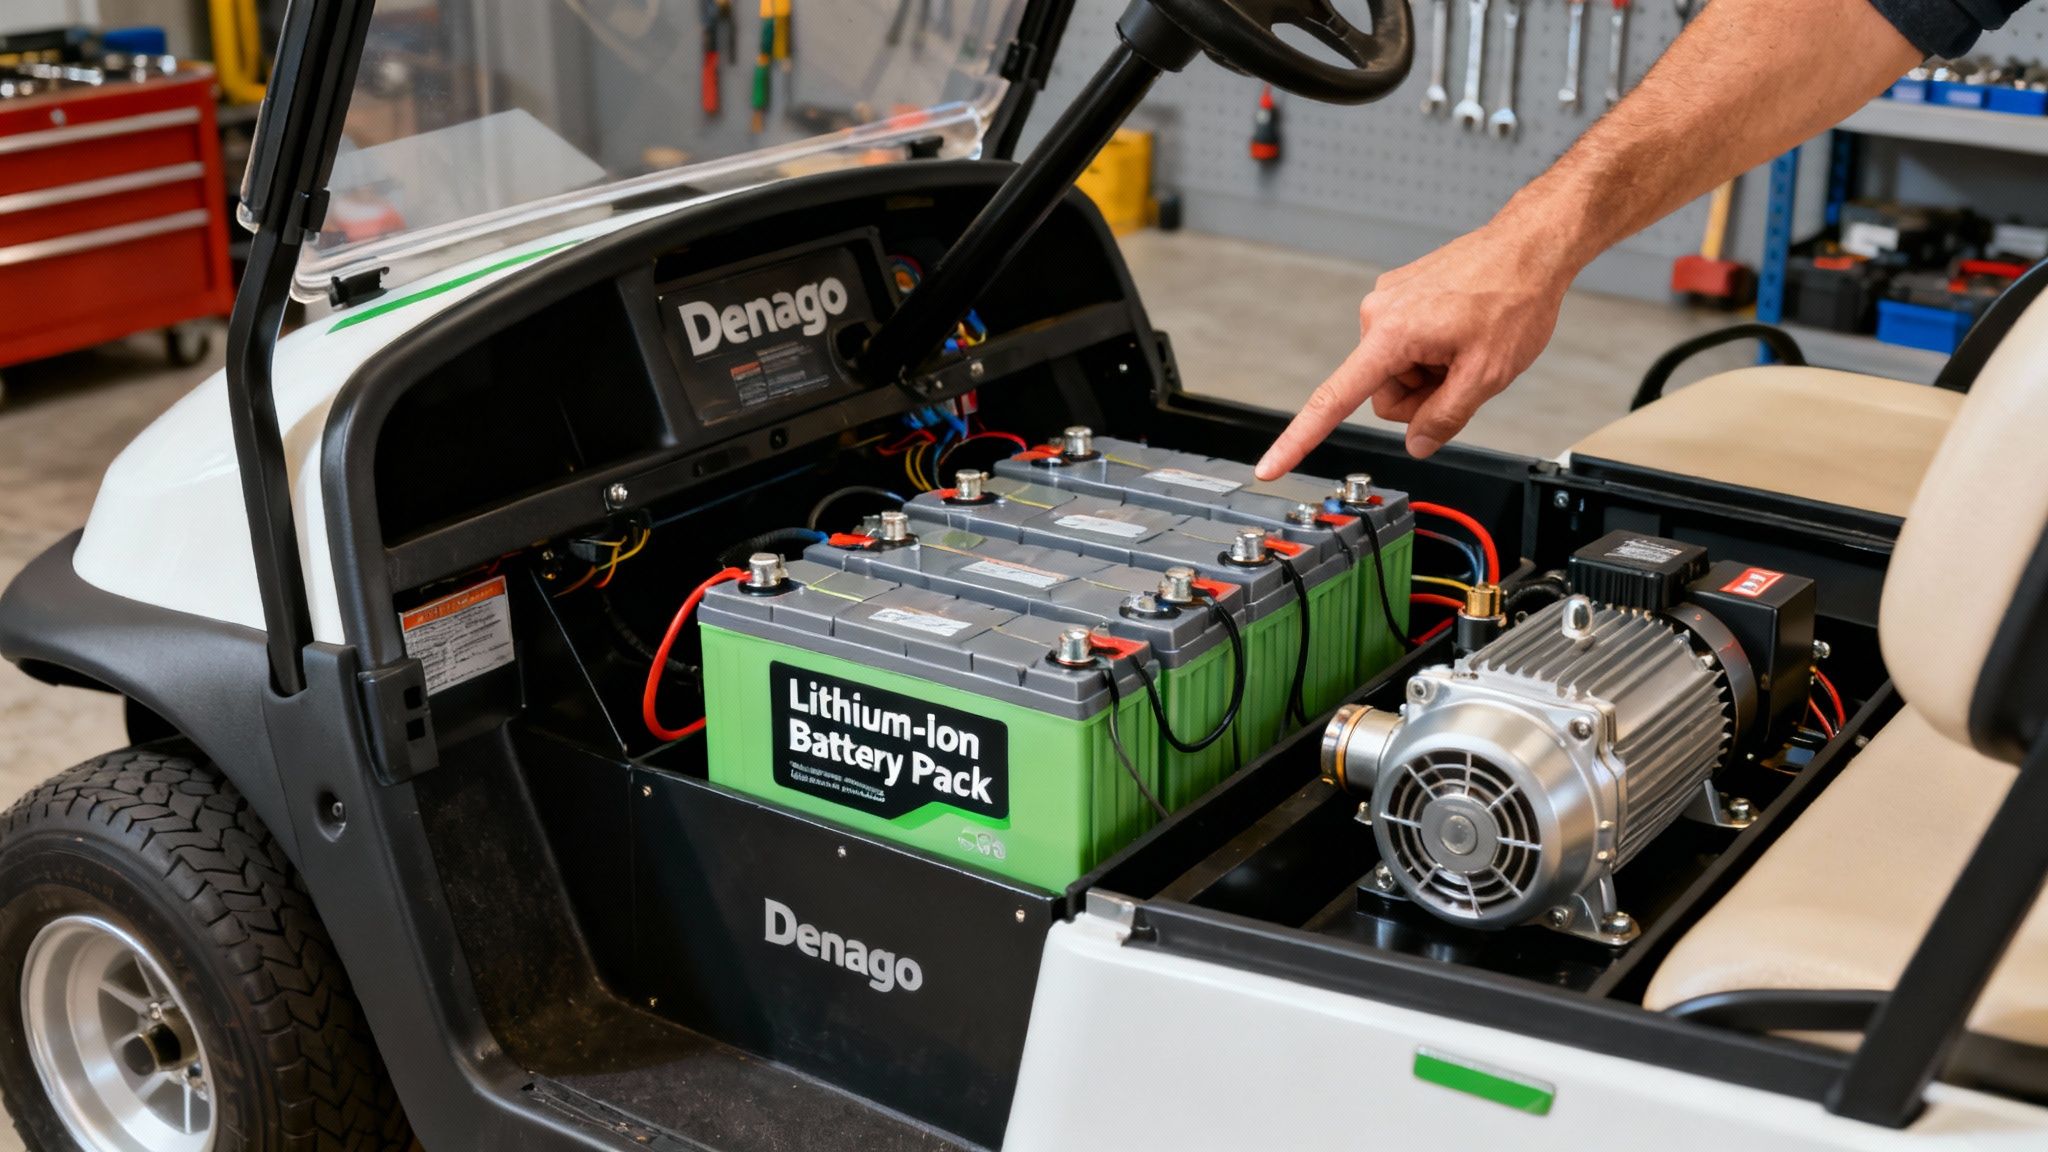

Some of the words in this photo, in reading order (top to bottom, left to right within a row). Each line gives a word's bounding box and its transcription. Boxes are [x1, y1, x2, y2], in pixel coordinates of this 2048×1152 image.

[678, 277, 848, 356] Denago
[789, 678, 980, 760] Lithium-Ion
[789, 717, 904, 787] Battery
[911, 750, 993, 805] Pack
[764, 897, 924, 993] Denago
